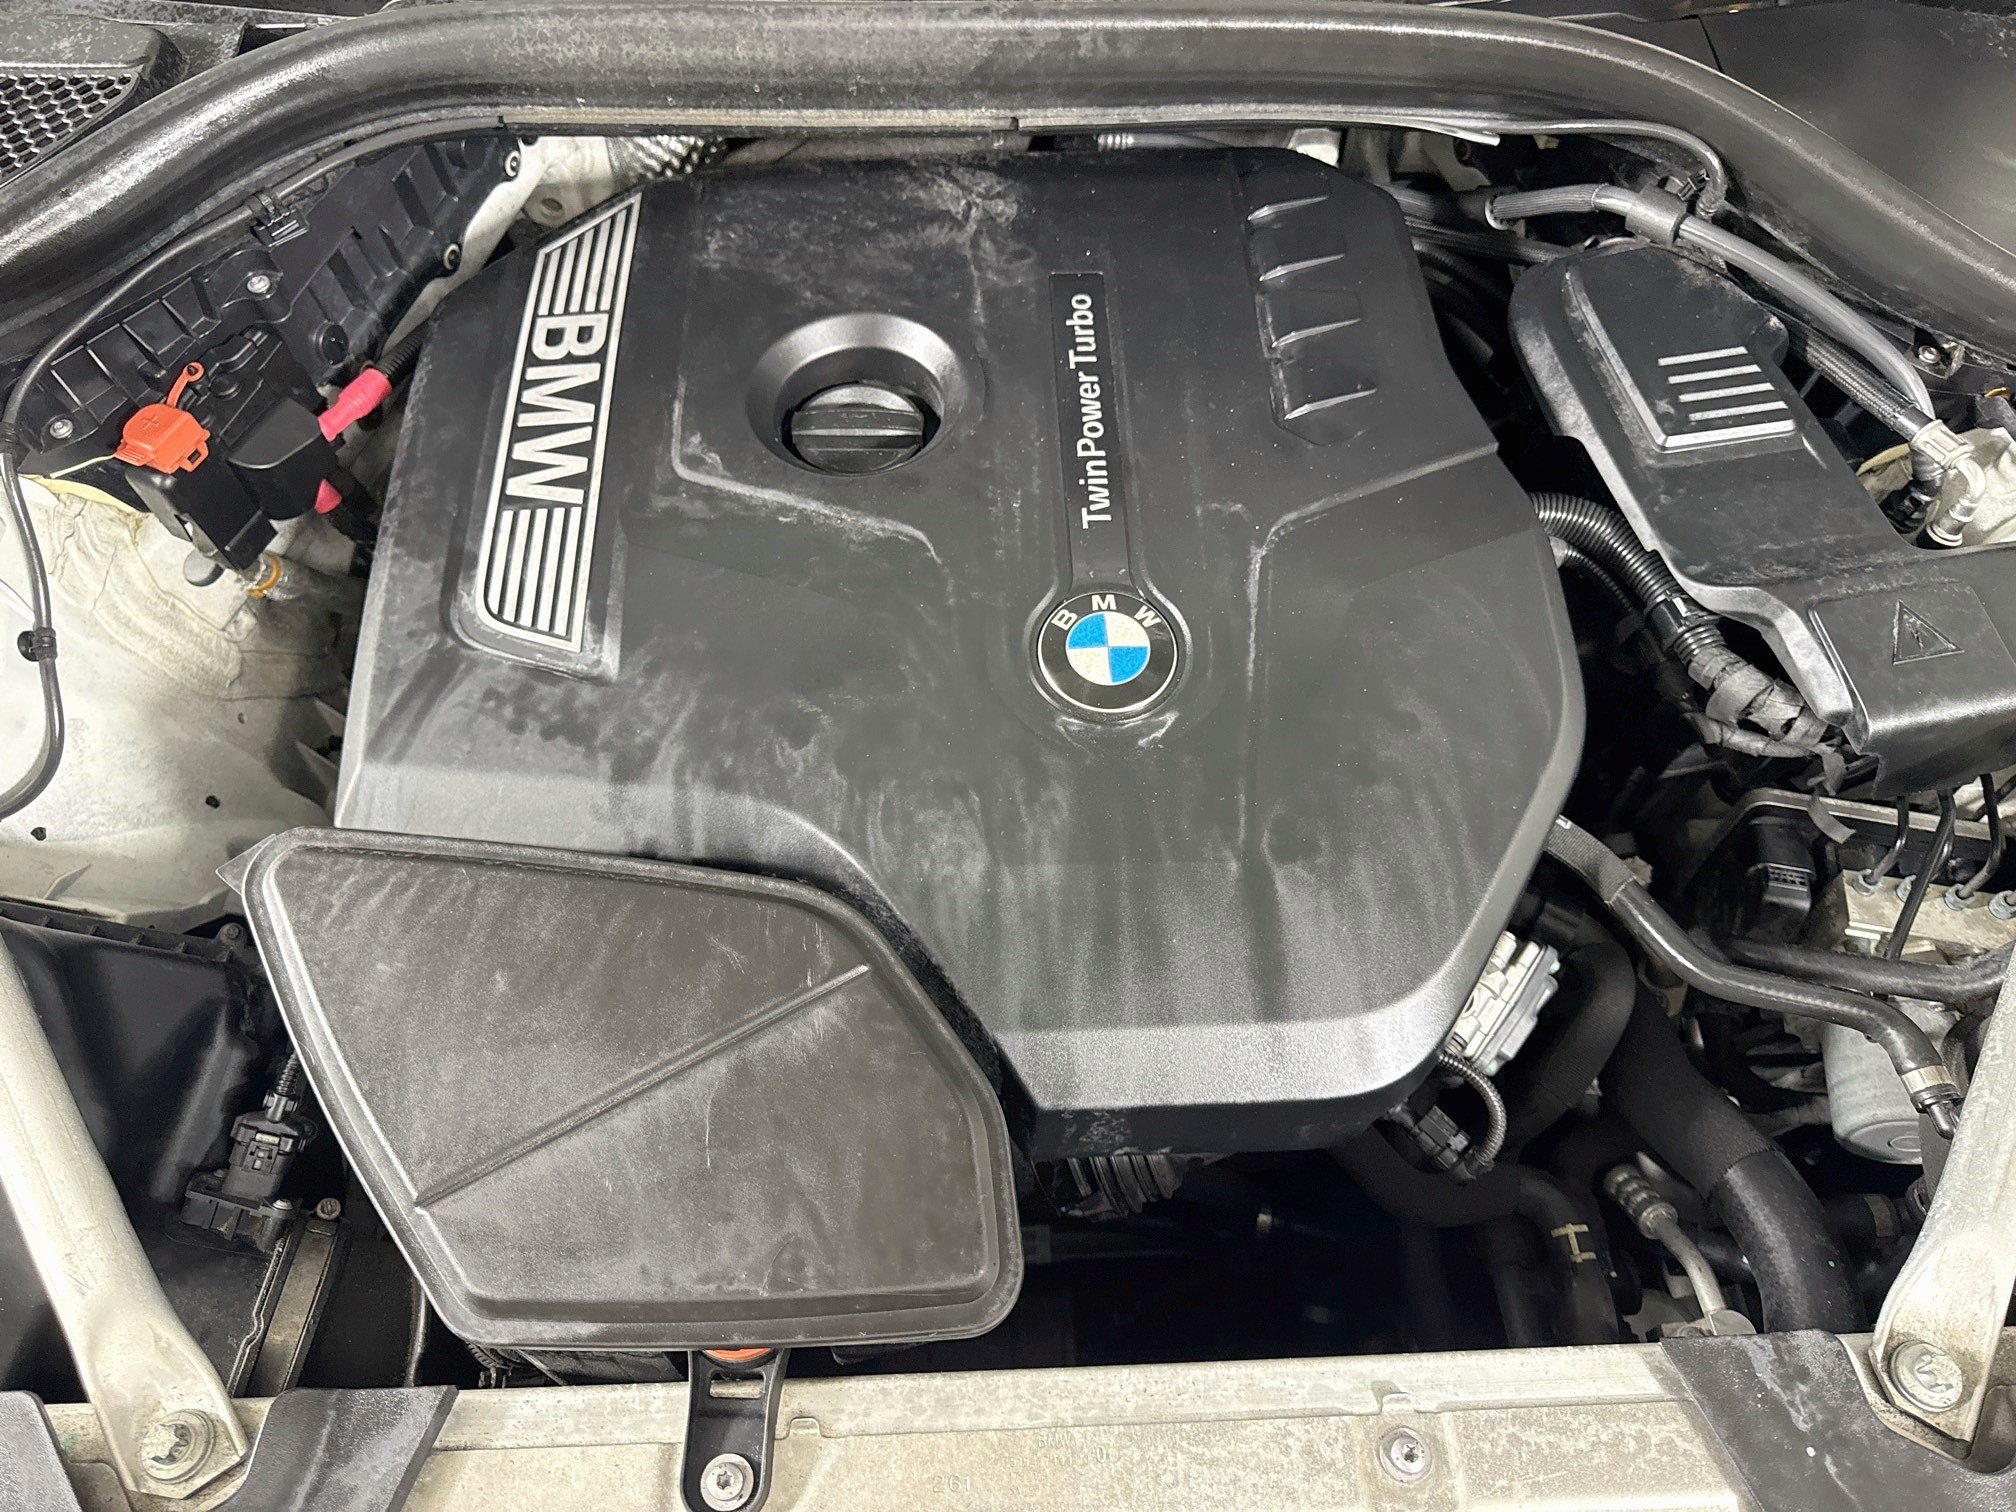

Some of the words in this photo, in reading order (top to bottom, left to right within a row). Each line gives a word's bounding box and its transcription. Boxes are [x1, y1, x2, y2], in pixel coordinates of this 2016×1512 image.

[1065, 293, 1098, 370] Turbo
[505, 312, 610, 505] BMW
[1077, 371, 1112, 530] TwinPower
[1050, 594, 1162, 631] BMW
